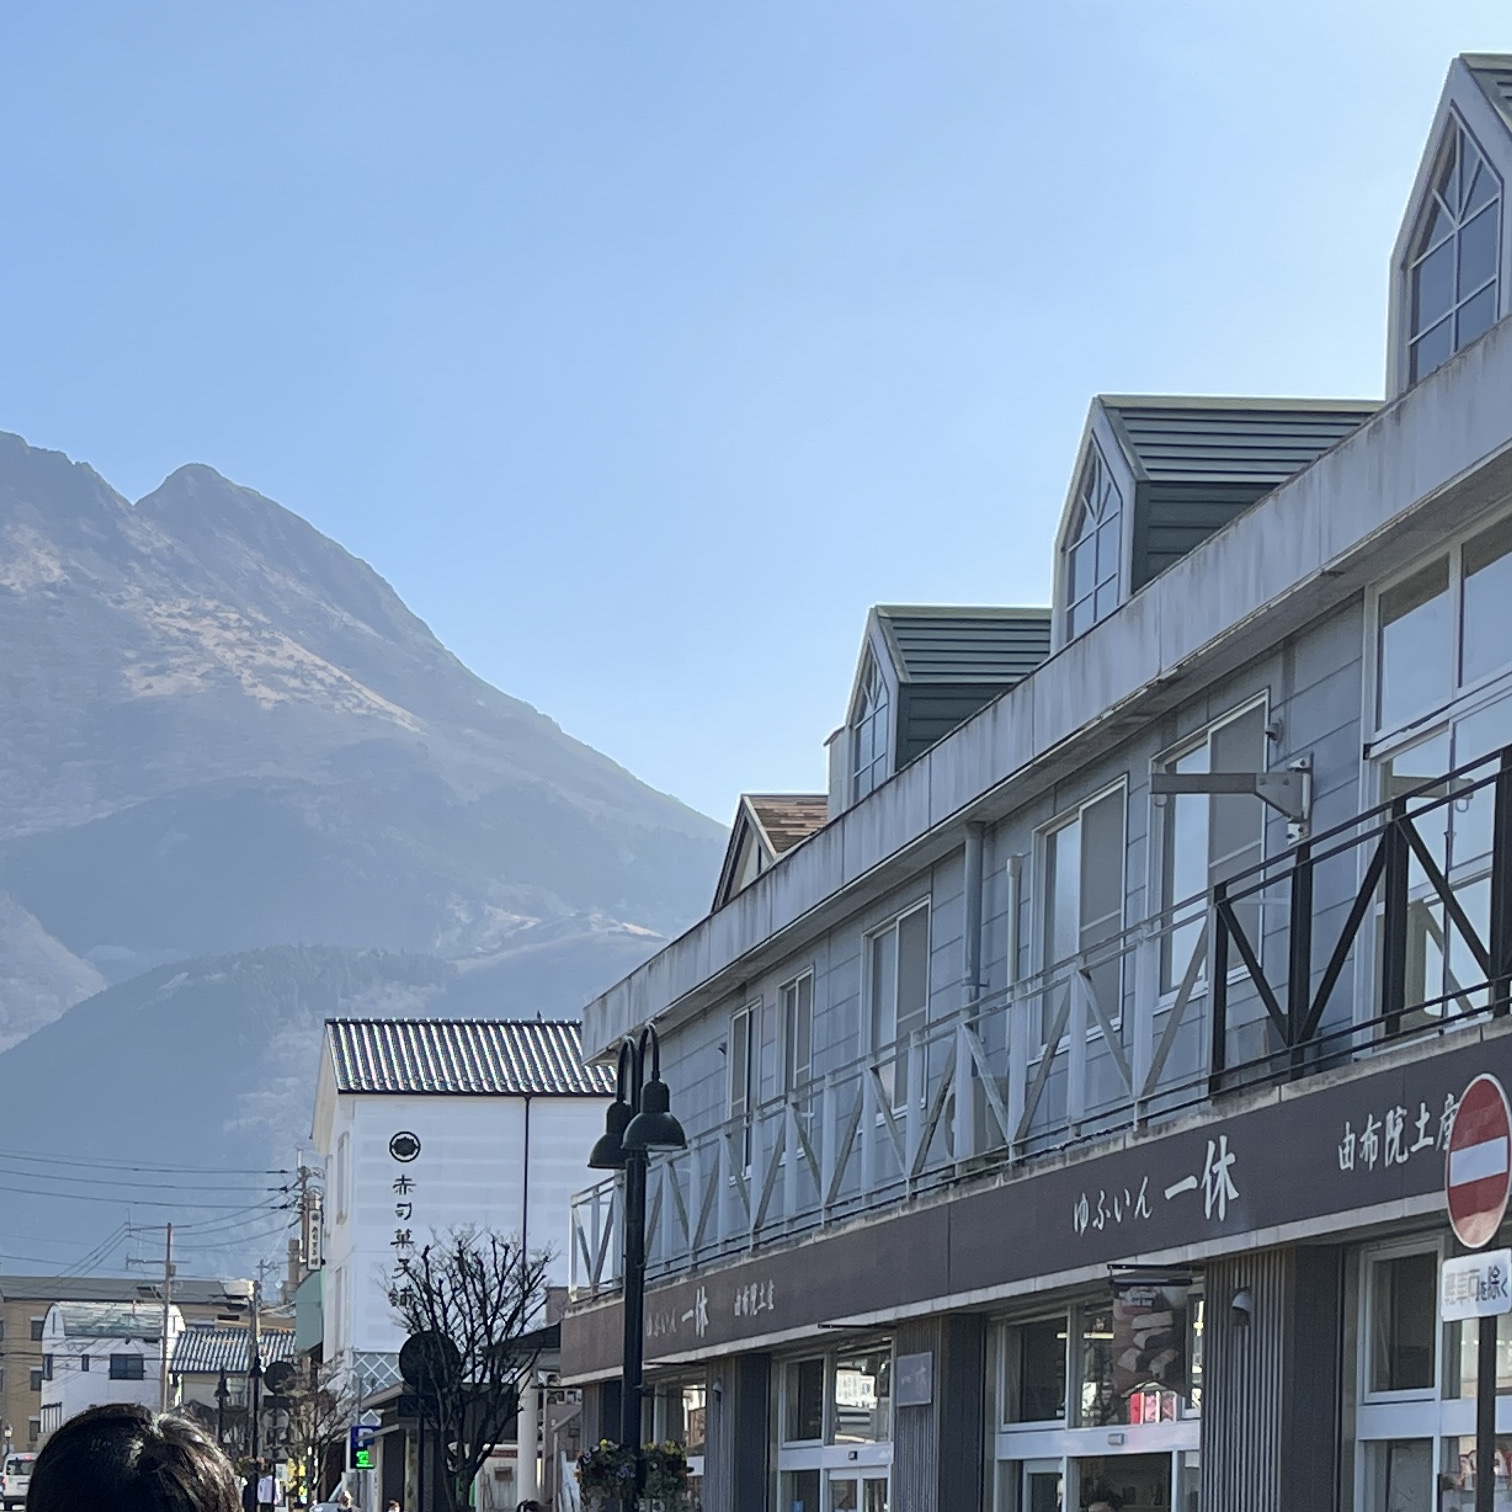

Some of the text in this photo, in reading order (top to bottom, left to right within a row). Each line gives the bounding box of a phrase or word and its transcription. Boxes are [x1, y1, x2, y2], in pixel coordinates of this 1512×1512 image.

[1074, 1135, 1240, 1237] ゆふいん 一休
[681, 1286, 709, 1338] 一休
[358, 1428, 374, 1447] P
